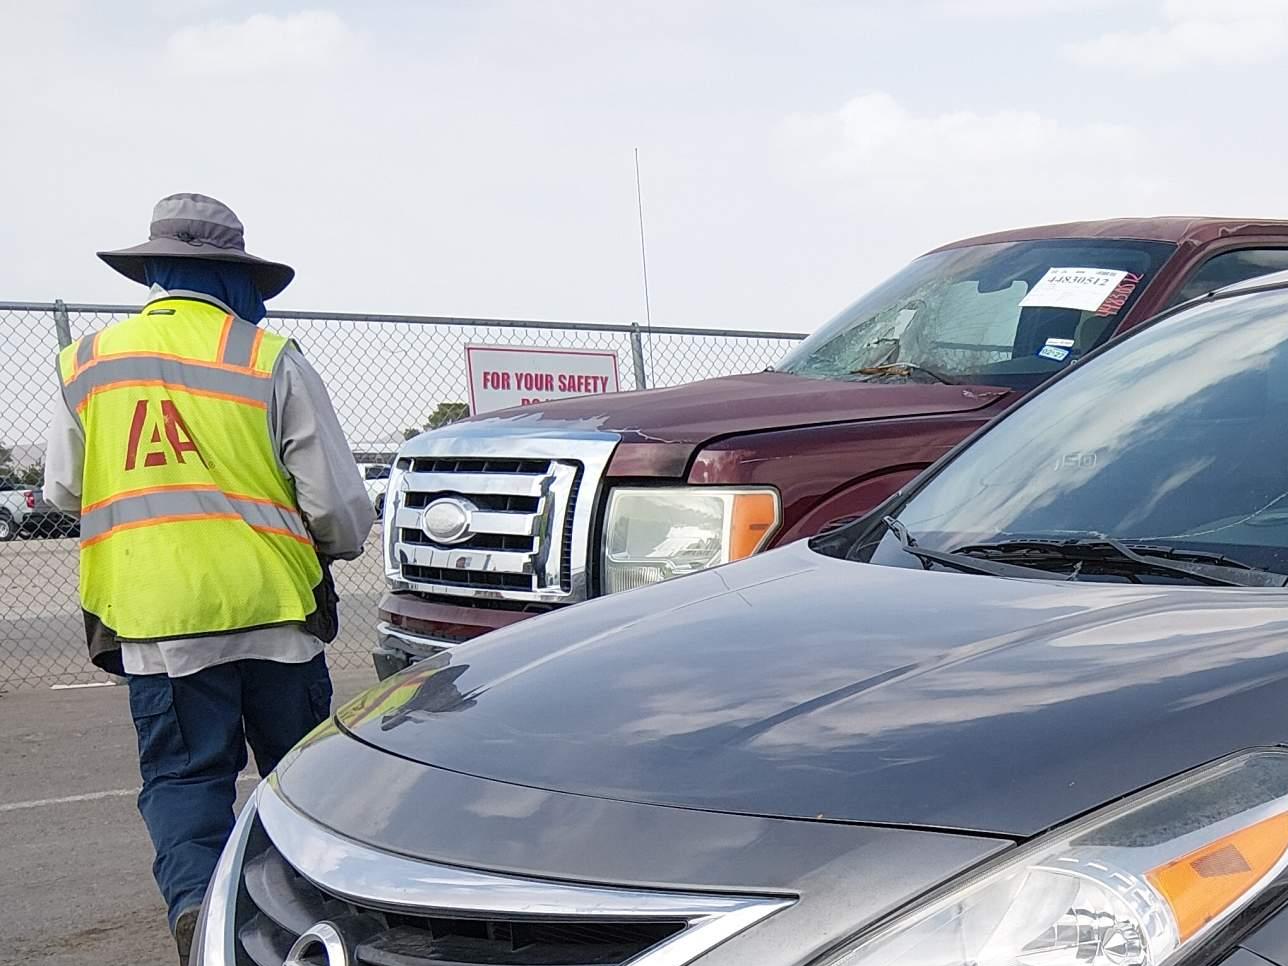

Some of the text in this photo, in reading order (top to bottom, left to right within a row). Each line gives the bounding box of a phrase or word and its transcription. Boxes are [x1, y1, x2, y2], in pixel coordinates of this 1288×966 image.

[1047, 276, 1110, 286] 44830512
[482, 371, 609, 394] FOR YOUR SAFETY
